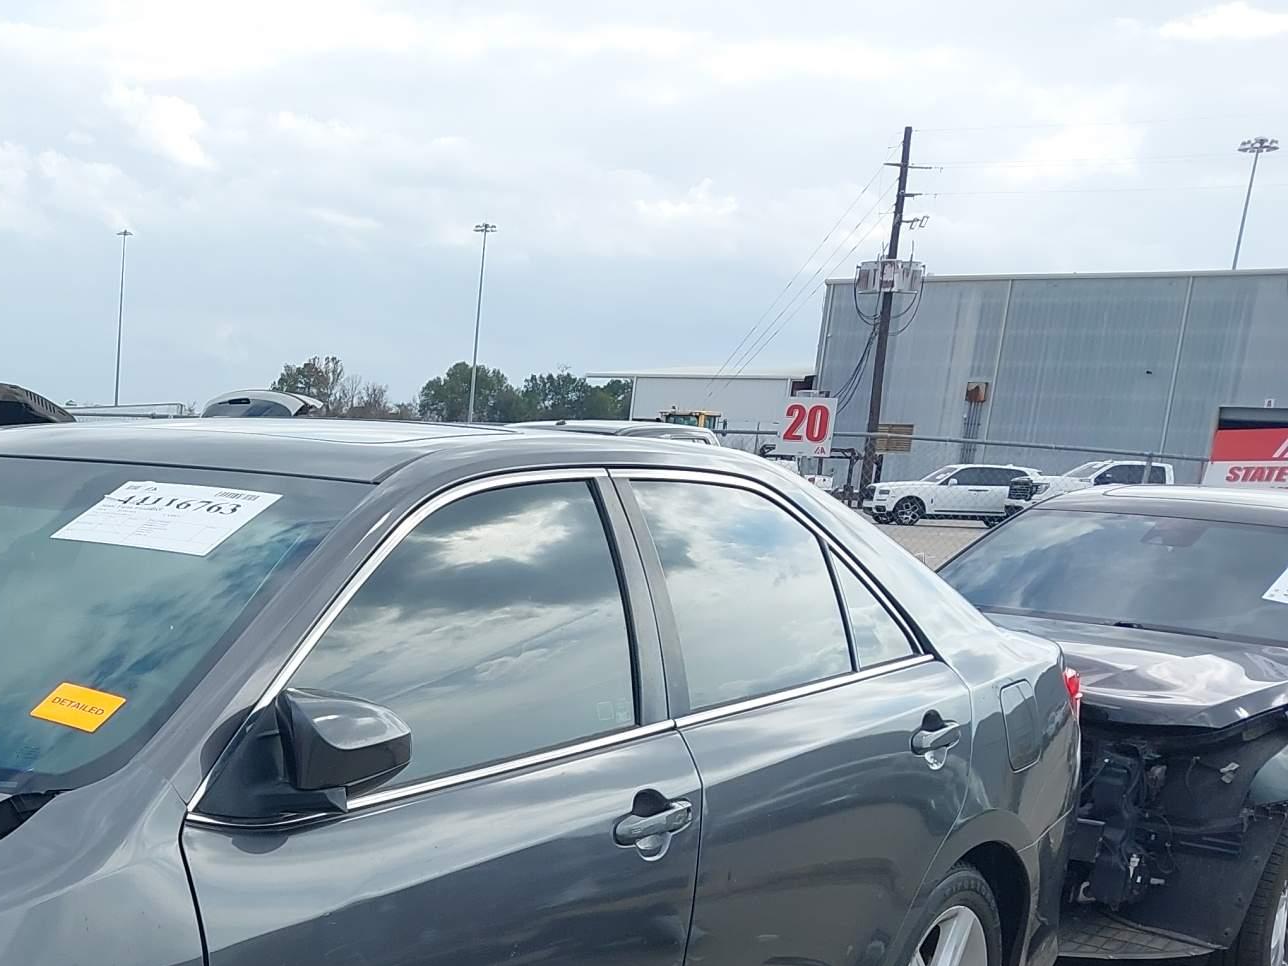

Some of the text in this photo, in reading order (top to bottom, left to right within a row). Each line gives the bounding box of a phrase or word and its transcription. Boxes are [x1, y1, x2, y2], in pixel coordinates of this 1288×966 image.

[783, 404, 829, 442] 20
[1225, 466, 1288, 482] STATE
[51, 696, 105, 716] DETAILED
